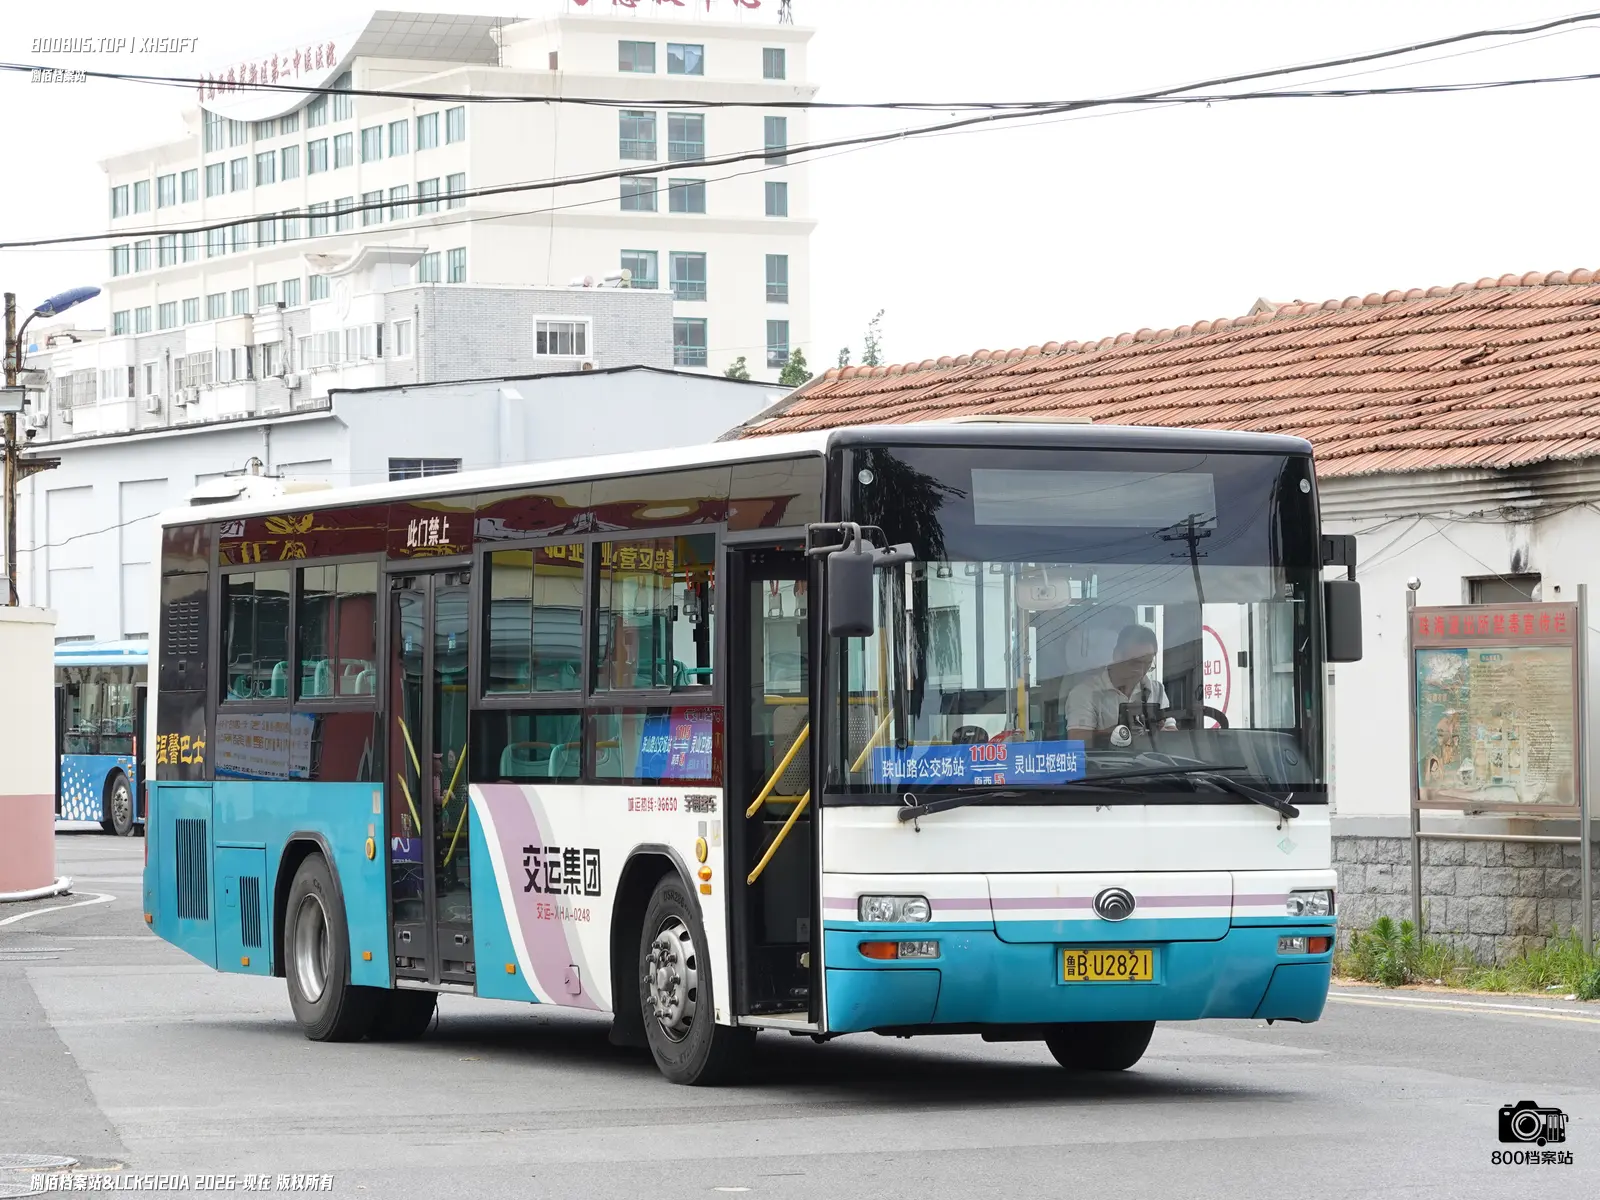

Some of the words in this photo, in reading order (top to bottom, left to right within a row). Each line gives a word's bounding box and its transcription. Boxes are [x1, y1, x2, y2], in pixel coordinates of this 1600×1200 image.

[406, 515, 450, 548] 此门禁上
[1418, 611, 1567, 637] 珠海派出所禁毒宣传栏
[1204, 660, 1221, 675] 出口
[1204, 683, 1222, 699] 停车
[969, 744, 1007, 761] 1105
[882, 757, 964, 778] 珠山路公交场站
[1015, 753, 1077, 775] 灵山卫枢纽站
[523, 845, 601, 896] 交运集团
[537, 903, 590, 922] 交运-XHA-0248
